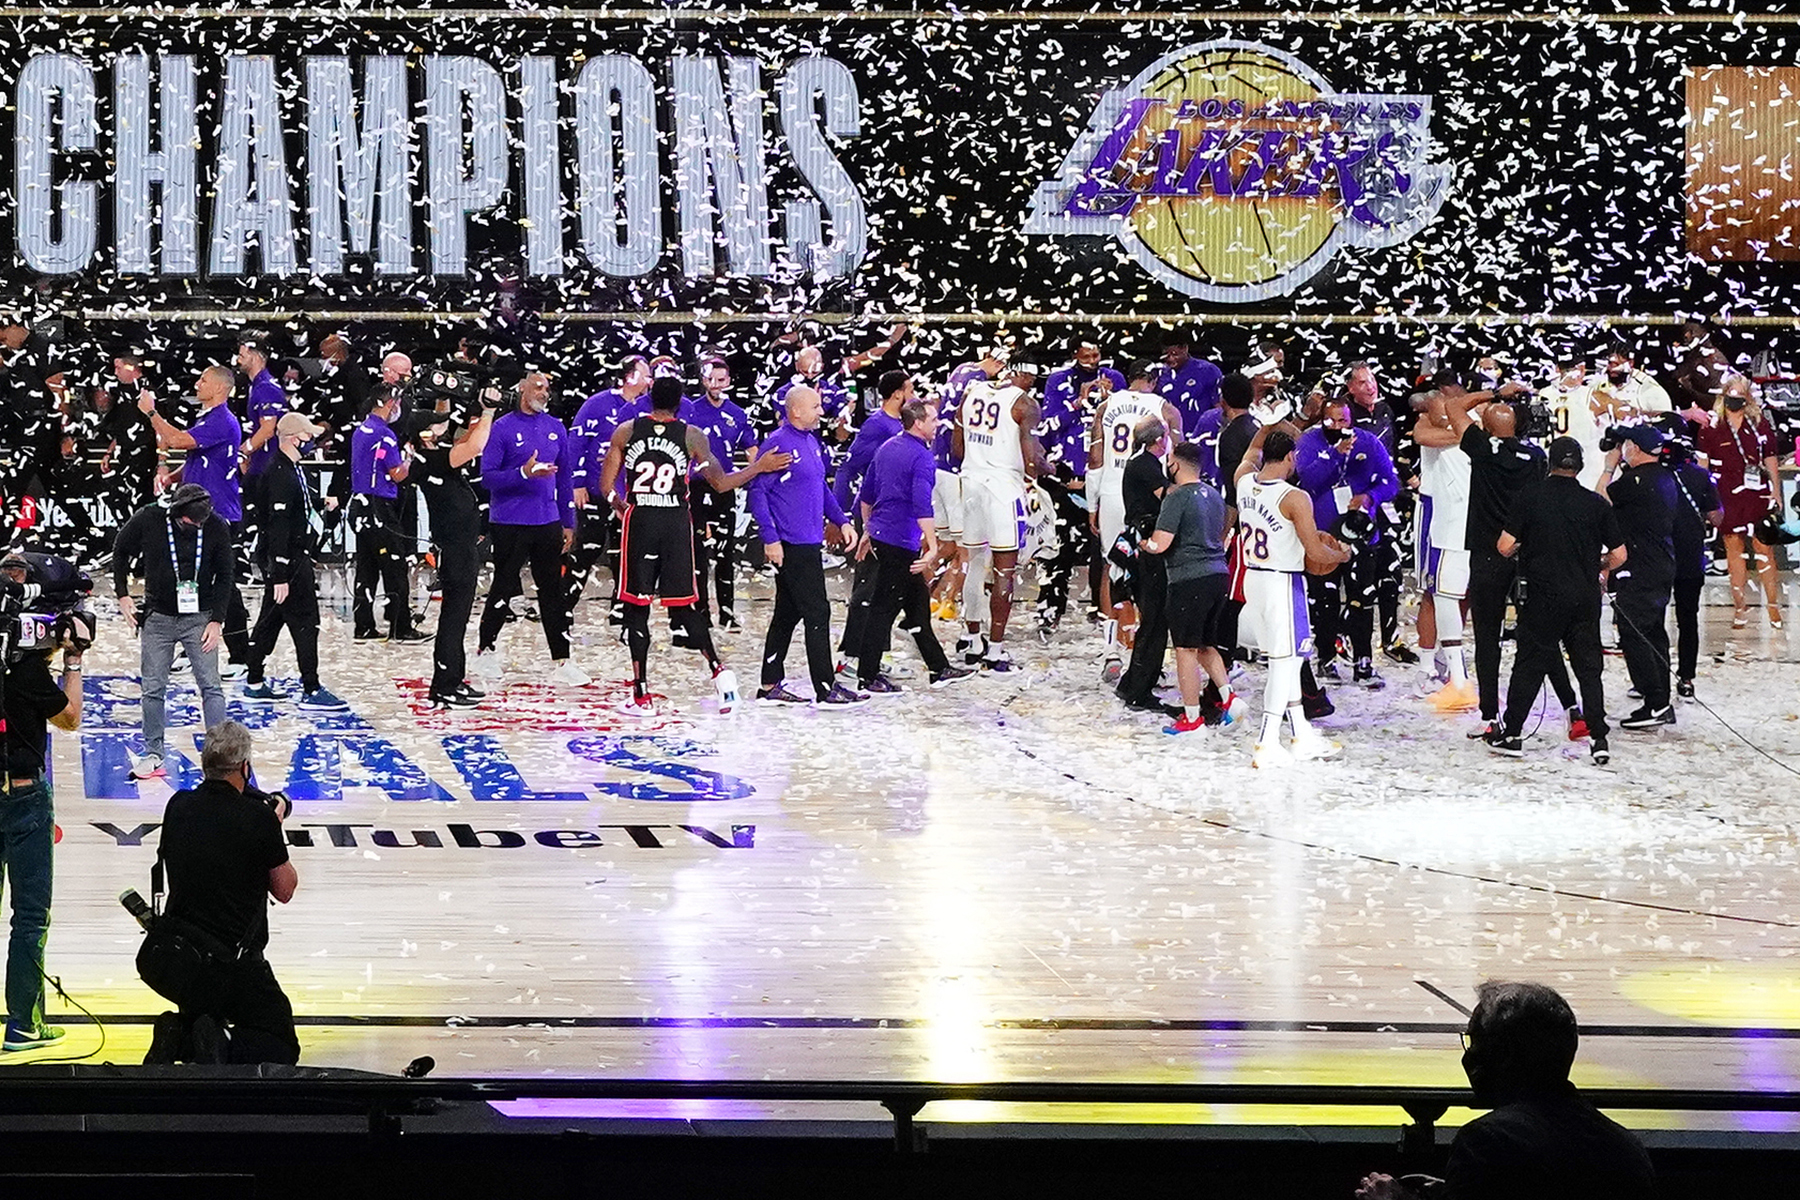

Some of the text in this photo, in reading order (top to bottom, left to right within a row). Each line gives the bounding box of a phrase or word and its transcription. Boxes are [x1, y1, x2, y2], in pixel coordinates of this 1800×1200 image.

[1175, 99, 1425, 122] LOS ANGELES
[13, 51, 867, 277] CHAMPIONS
[1062, 98, 1413, 230] LAKERS
[969, 398, 1000, 430] 39
[647, 436, 688, 476] ECONOMICS
[632, 461, 677, 495] 28
[1257, 503, 1283, 532] NAMES
